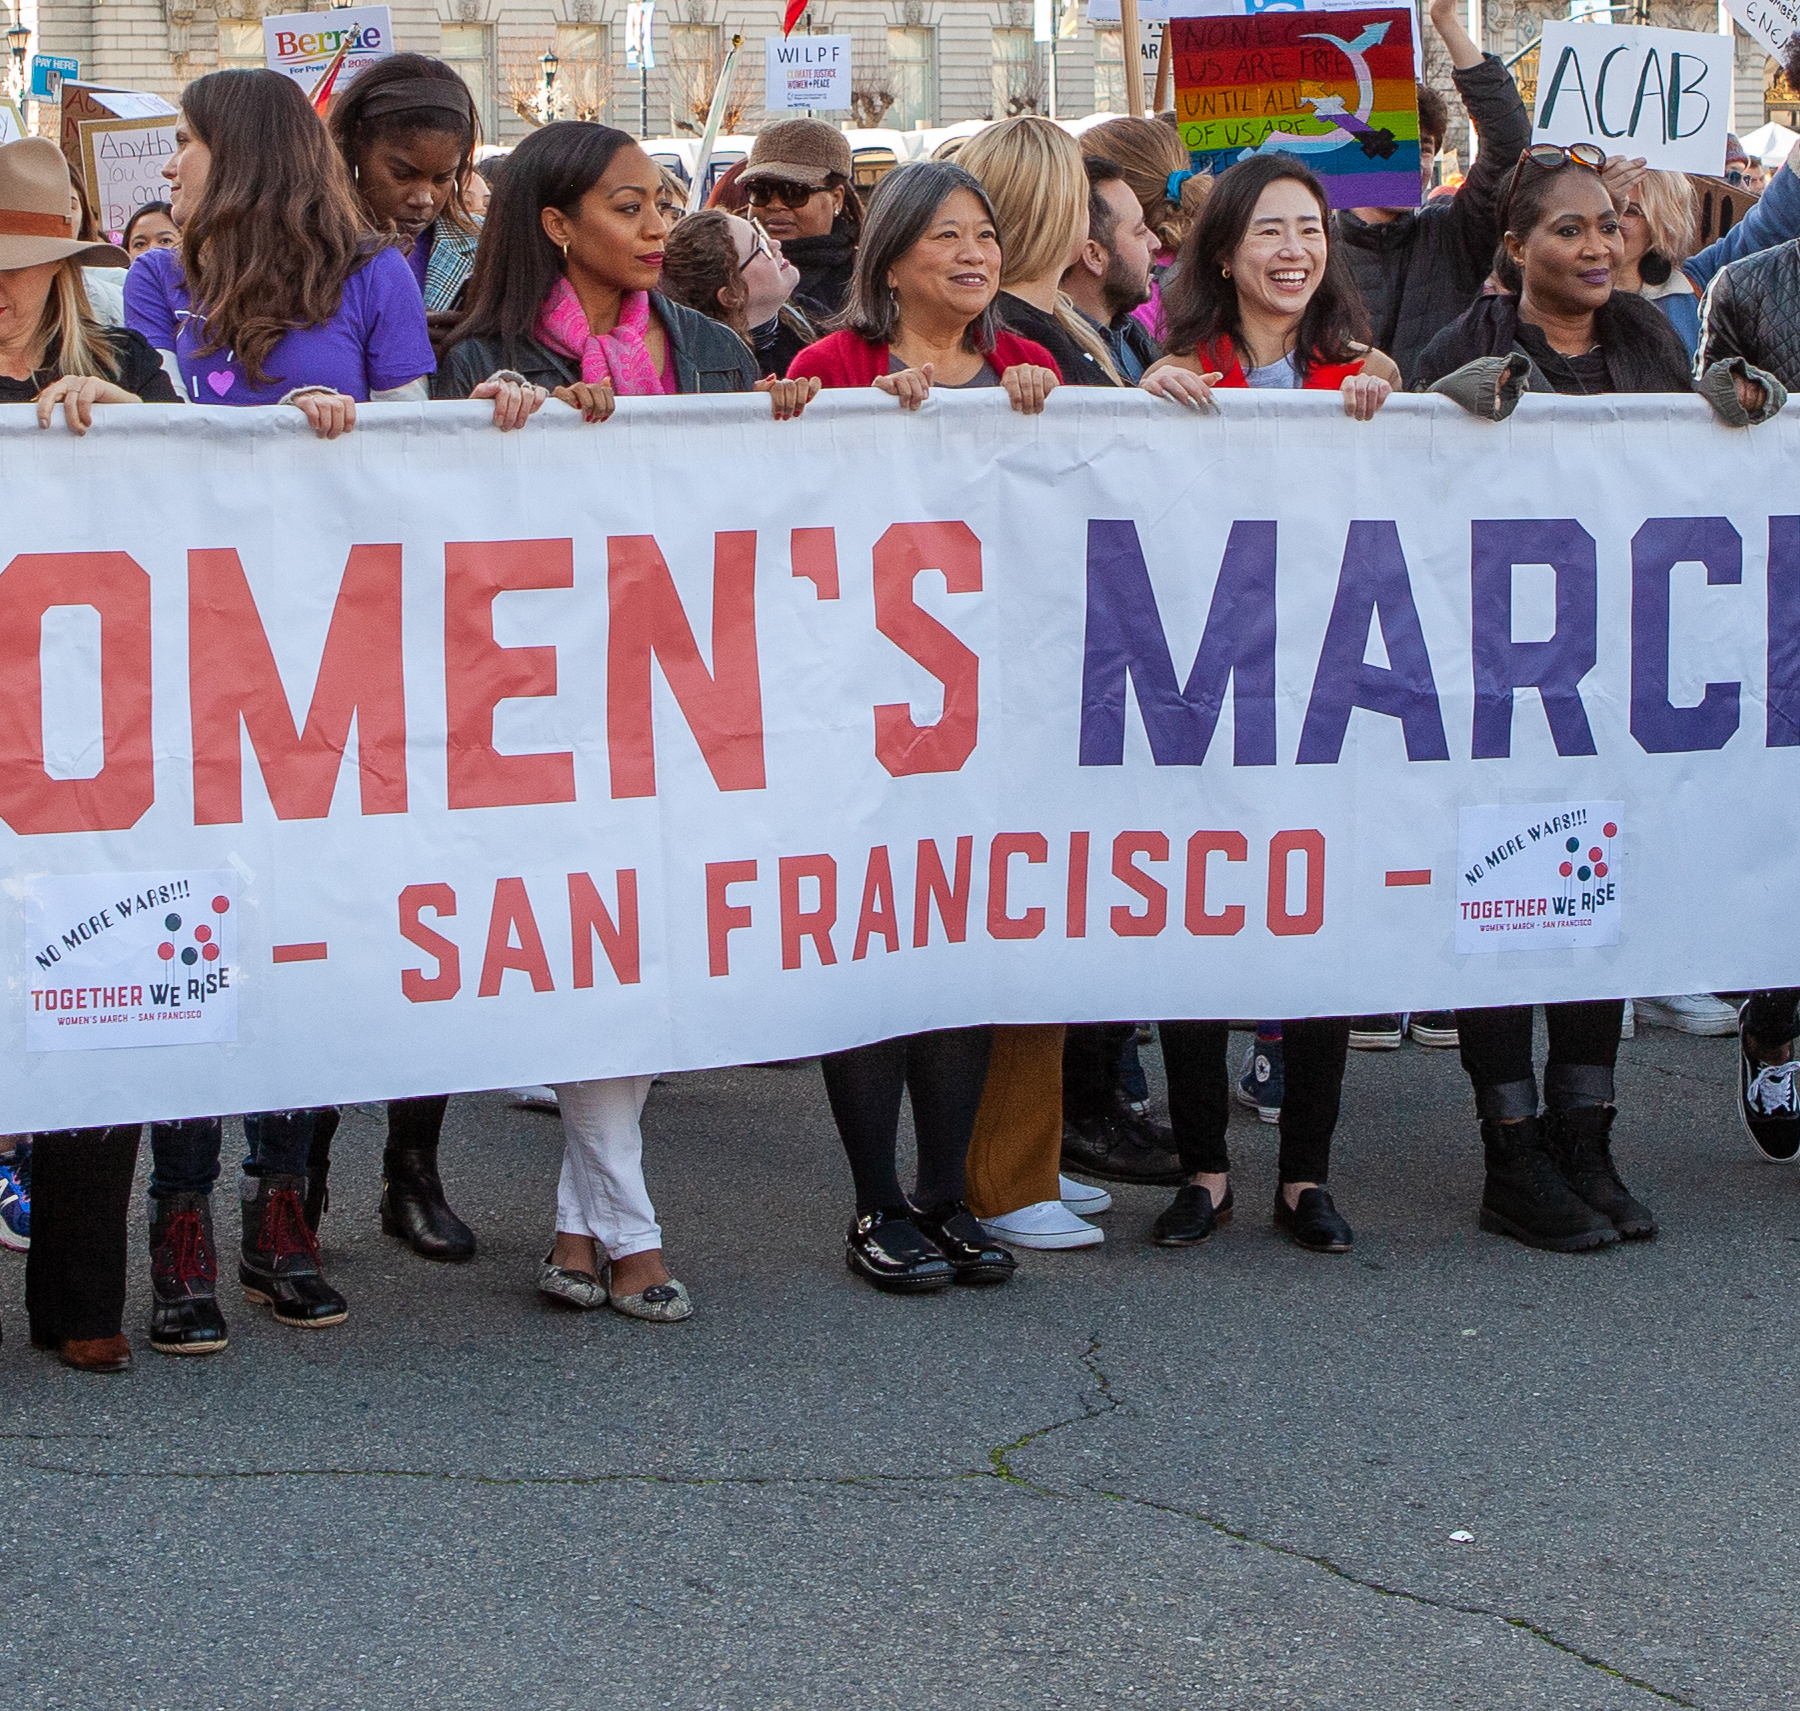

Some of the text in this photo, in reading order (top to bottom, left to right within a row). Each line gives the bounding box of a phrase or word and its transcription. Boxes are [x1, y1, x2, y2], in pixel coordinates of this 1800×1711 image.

[1183, 17, 1272, 49] NONE
[35, 56, 77, 72] PAY HERE
[786, 68, 837, 79] CLIMATE JUSTICE
[1186, 58, 1222, 83] US
[1233, 53, 1287, 81] ARE
[1184, 87, 1302, 116] UNTIL ALL
[1537, 45, 1710, 145] ACAB
[100, 129, 175, 163] Anyth
[1185, 118, 1306, 147] OF US ARE
[1464, 808, 1588, 887] NO MORE WARS!!!
[399, 868, 642, 1004] SAN
[705, 828, 1327, 977] FRANCISCO
[1460, 883, 1616, 920] TOGETHER WE RISE
[35, 879, 191, 972] NO MORE WARS!!!
[1479, 918, 1592, 932] WOMEN'S MARCH SAN FRANCISCO
[31, 967, 230, 1011] TOGETHER WE RISE
[57, 1010, 202, 1026] WOMEN'S MARCH SAN FRANCISCO
